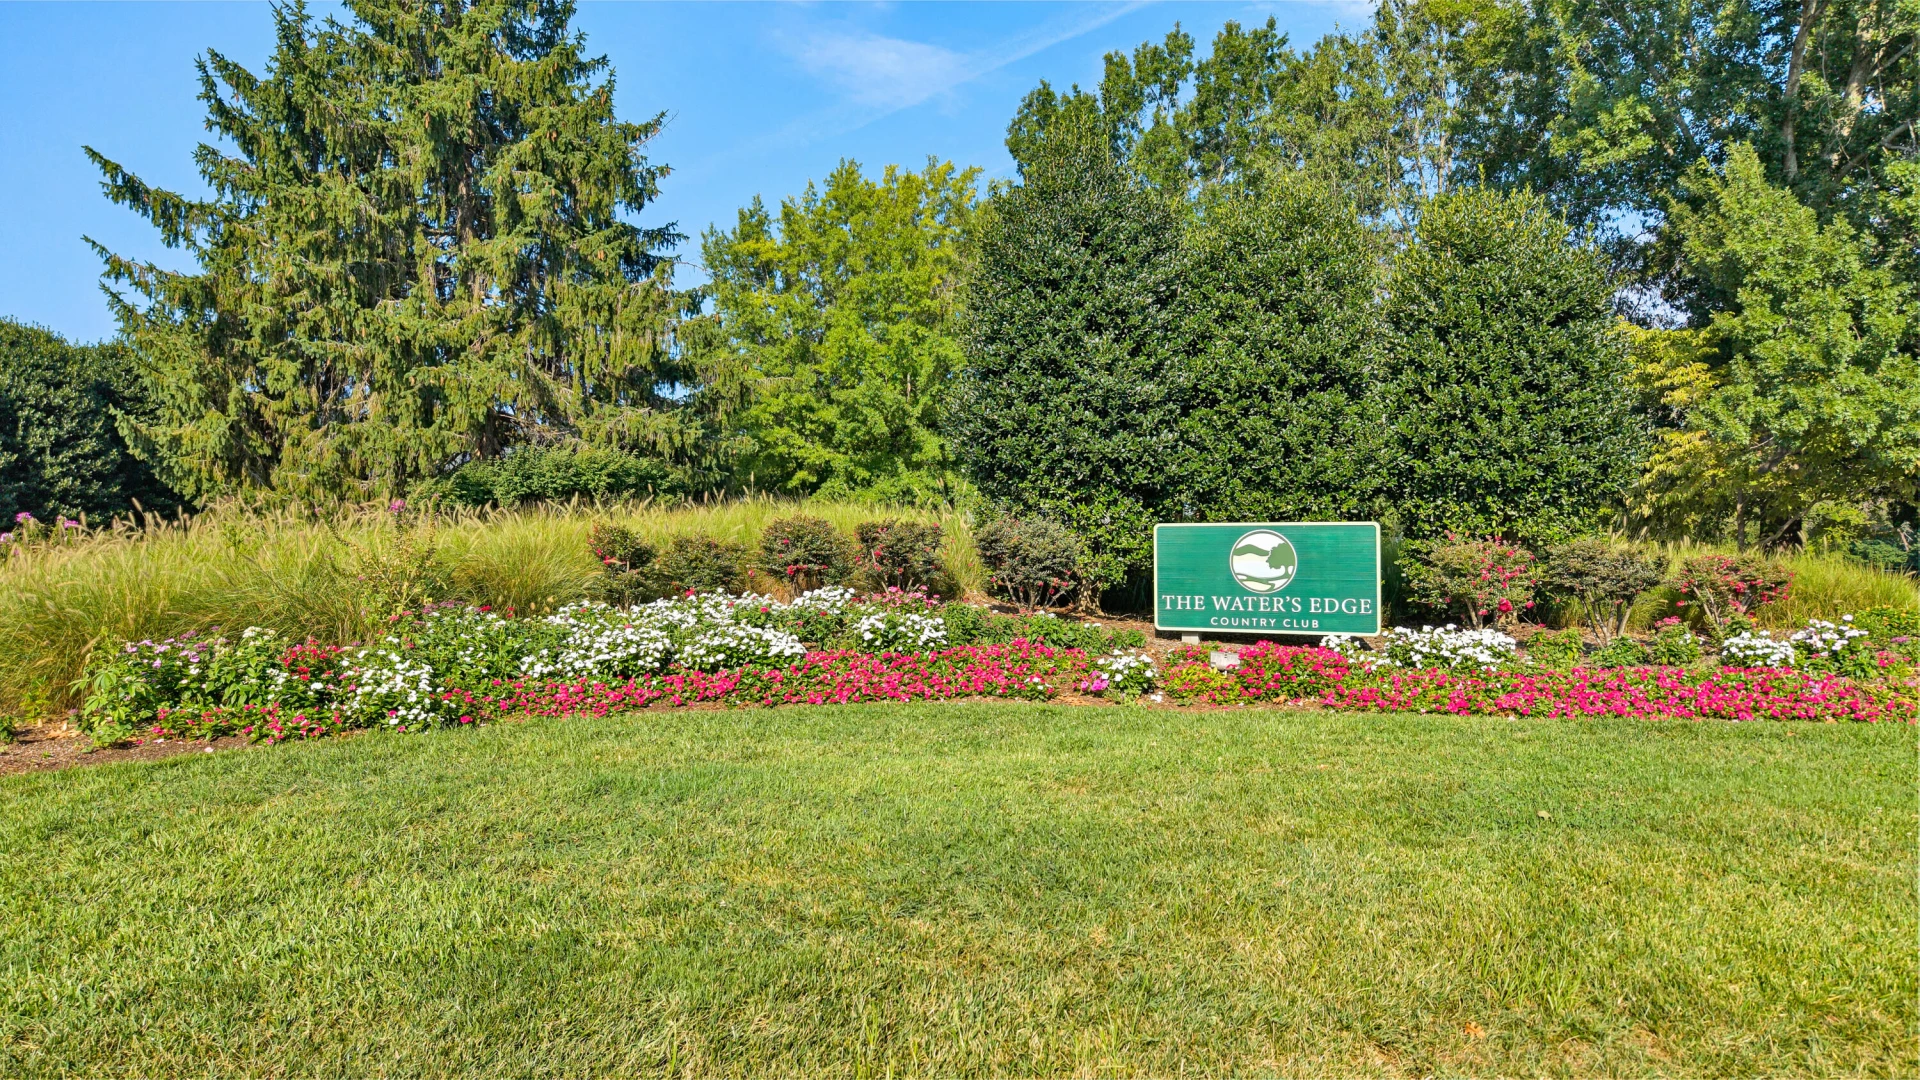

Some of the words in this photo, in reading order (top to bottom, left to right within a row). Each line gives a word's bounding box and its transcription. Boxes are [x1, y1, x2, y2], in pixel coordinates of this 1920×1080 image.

[1162, 595, 1205, 610] THE
[1211, 596, 1302, 613] WATER’S
[1309, 597, 1372, 614] EDGE
[1210, 616, 1277, 627] COUNTRY
[1283, 618, 1319, 628] CLUB
